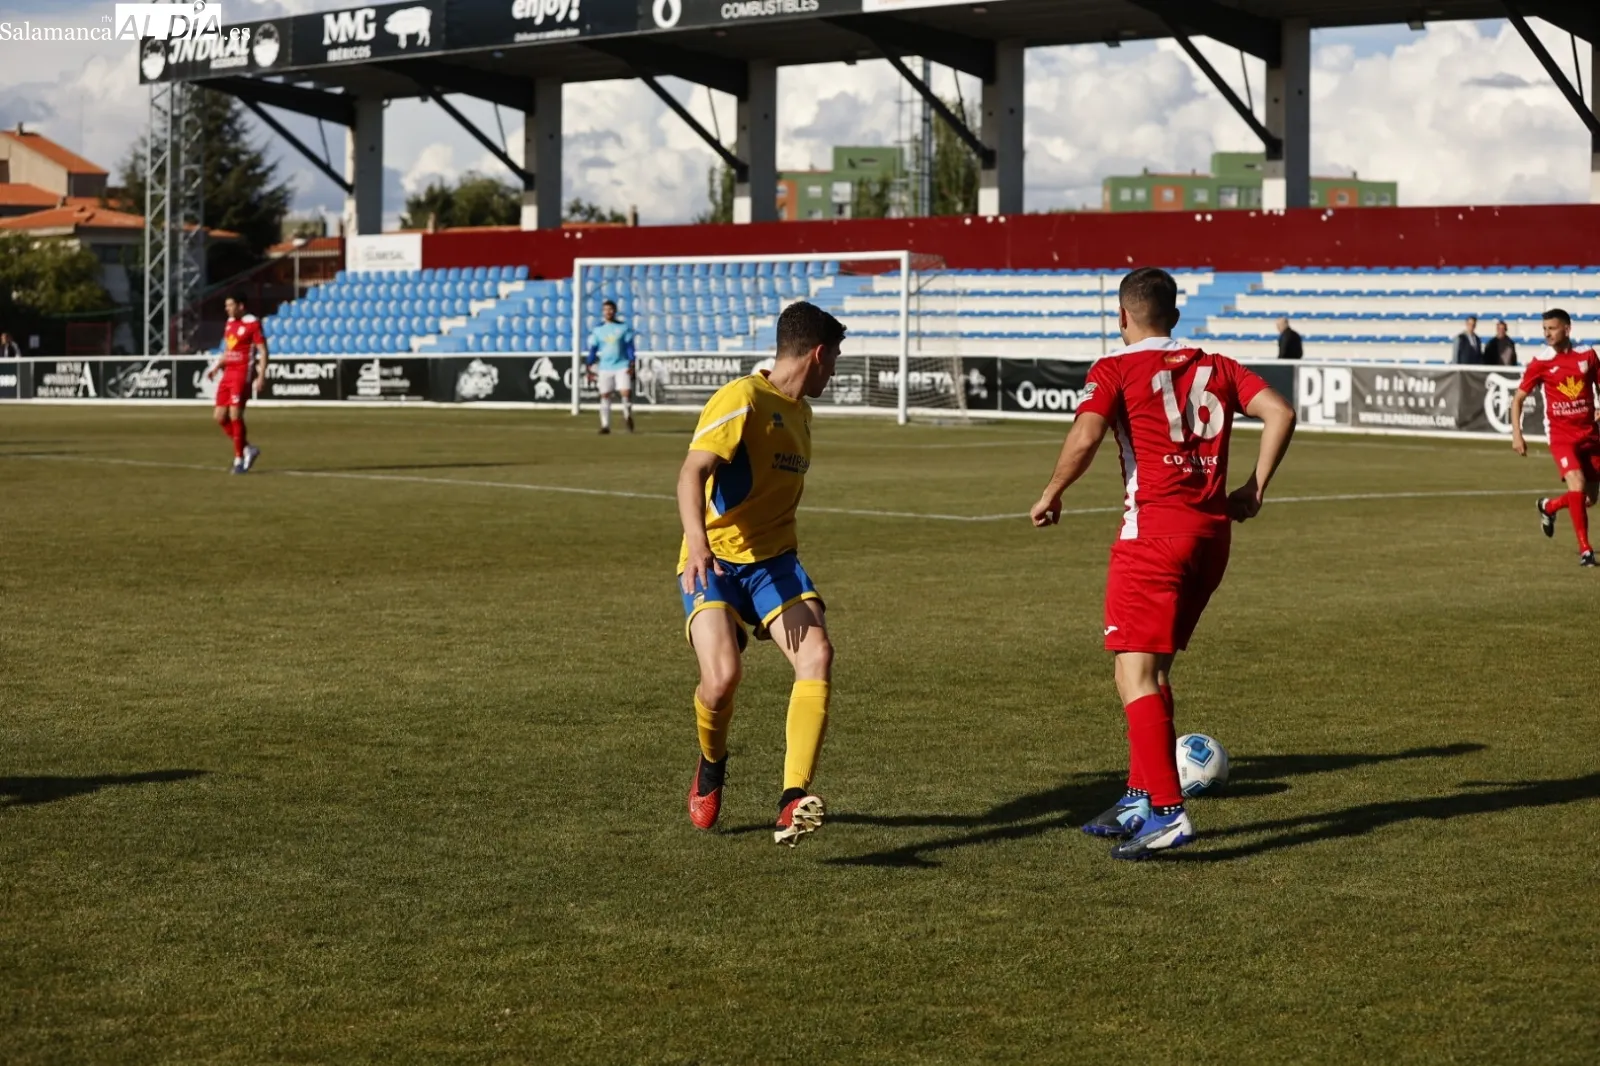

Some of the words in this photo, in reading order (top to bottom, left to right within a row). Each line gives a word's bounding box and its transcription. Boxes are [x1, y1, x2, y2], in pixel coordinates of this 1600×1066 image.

[721, 0, 819, 20] COMBUSTIBLES
[322, 8, 377, 45] MMG
[879, 370, 955, 394] MRETA
[1016, 380, 1084, 410] Oron
[1151, 365, 1225, 442] 16
